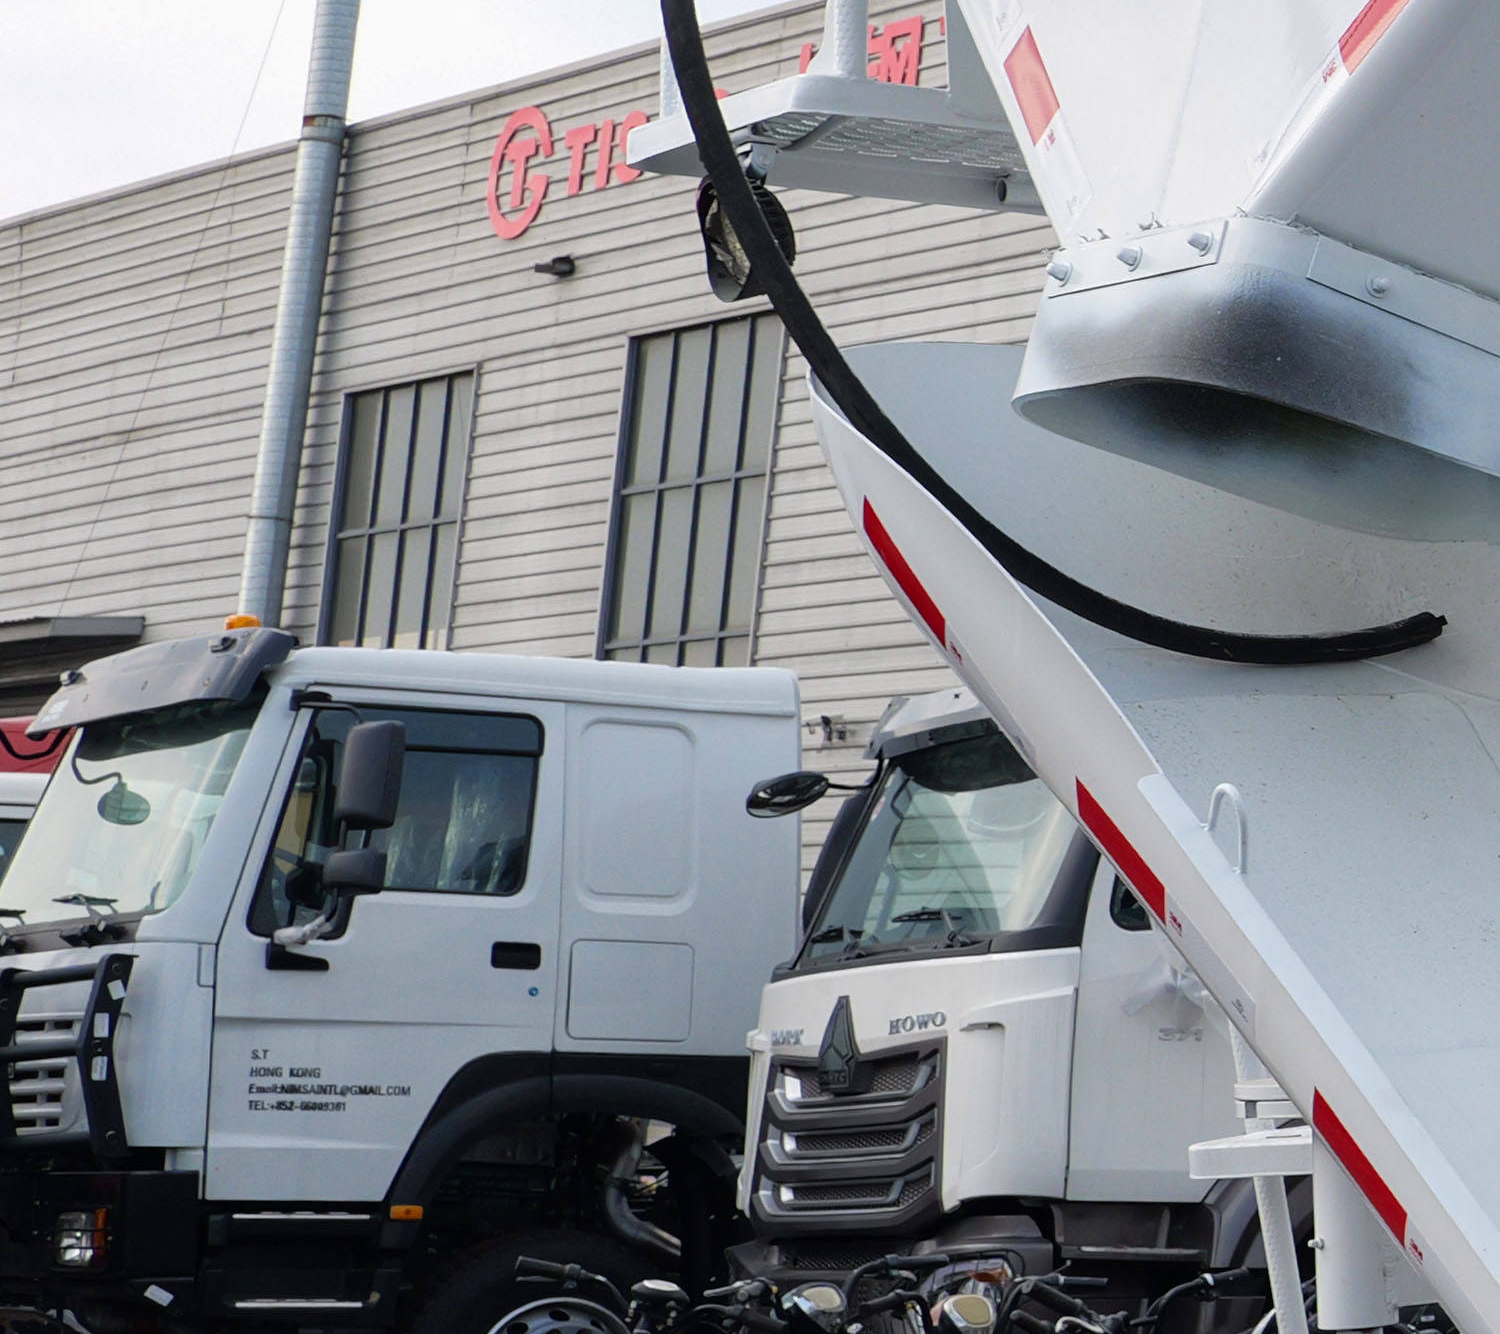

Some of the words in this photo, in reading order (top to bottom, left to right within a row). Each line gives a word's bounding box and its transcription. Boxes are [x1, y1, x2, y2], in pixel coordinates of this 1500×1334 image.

[888, 1011, 947, 1035] HOWO
[249, 1067, 283, 1078] HONG
[289, 1067, 322, 1079] KONG
